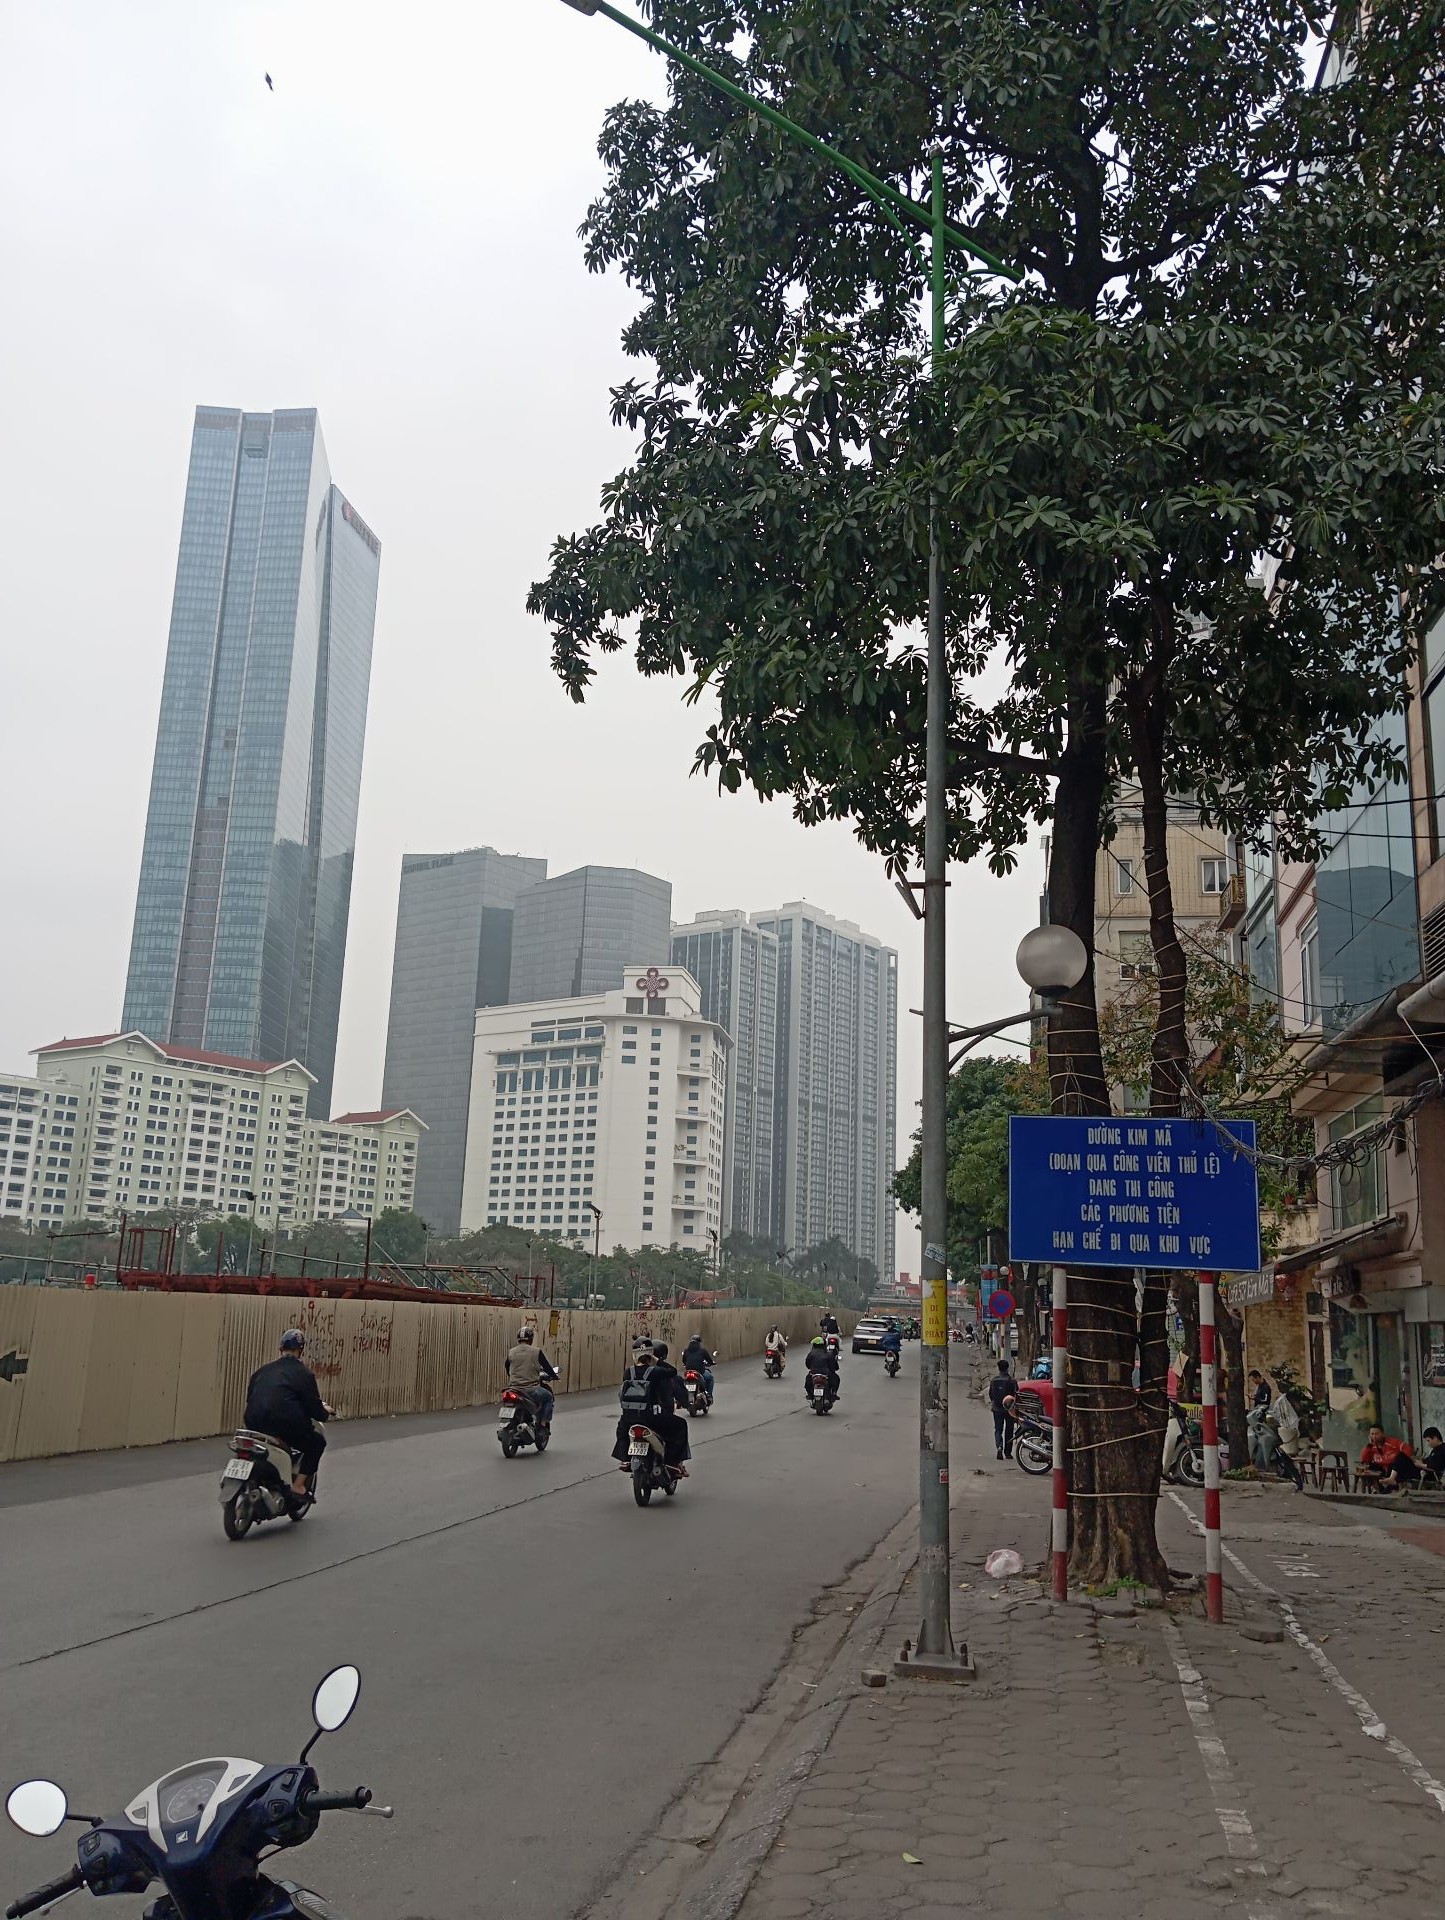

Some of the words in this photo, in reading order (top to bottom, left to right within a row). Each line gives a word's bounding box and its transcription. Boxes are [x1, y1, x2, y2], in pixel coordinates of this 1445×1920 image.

[1088, 1122, 1121, 1144] ĐƯỜNG
[1128, 1128, 1147, 1146] KIM
[1155, 1124, 1172, 1146] MÃ
[1087, 1154, 1107, 1172] QUA
[1114, 1150, 1139, 1172] CÔNG
[1147, 1151, 1170, 1172] VIÊN
[1178, 1150, 1197, 1174] THỦ
[1125, 1180, 1140, 1197] THI
[1148, 1176, 1174, 1198] CÔNG
[1081, 1199, 1100, 1221] CÁC
[1109, 1204, 1149, 1223] PHƯƠNG
[1157, 1202, 1180, 1229] TIỆN
[1053, 1231, 1074, 1253] HẠN
[1083, 1224, 1104, 1249] CHẾ
[1111, 1233, 1120, 1250] ĐI
[1130, 1234, 1150, 1253] QUA
[1159, 1235, 1179, 1253] KHU
[1189, 1236, 1210, 1260] VỰC
